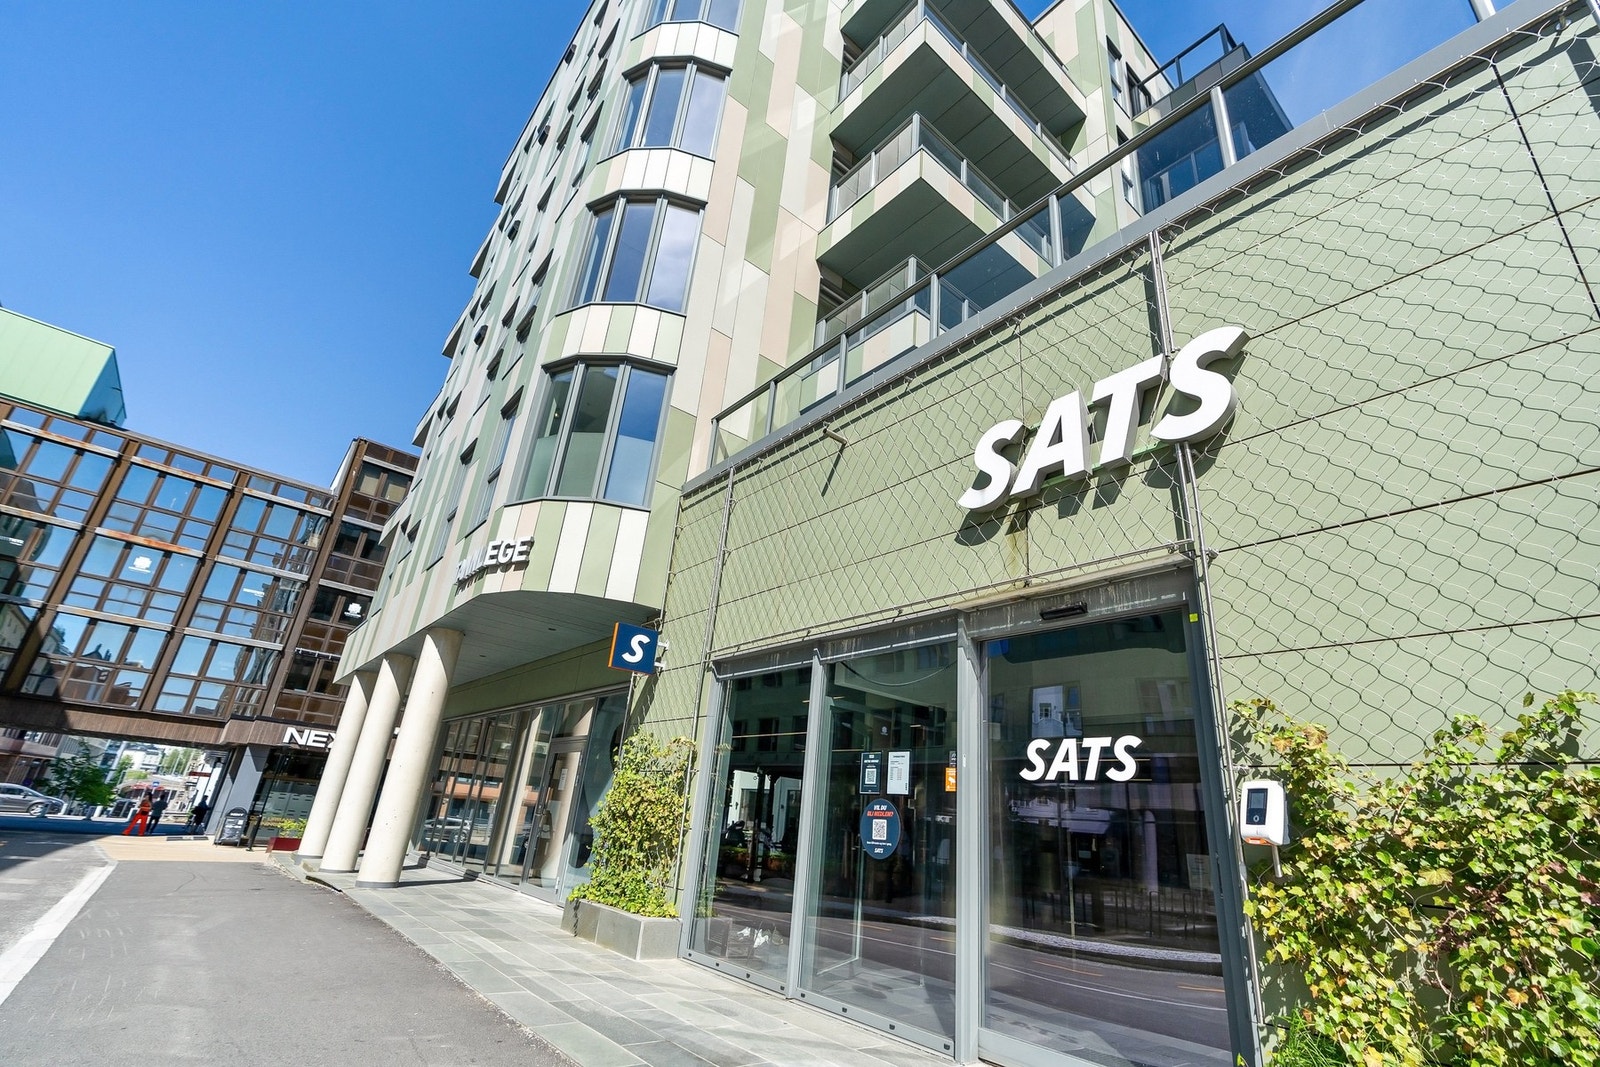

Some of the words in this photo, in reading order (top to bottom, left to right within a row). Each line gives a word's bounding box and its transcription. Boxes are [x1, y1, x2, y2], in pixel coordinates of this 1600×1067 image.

[957, 326, 1249, 512] SATS
[621, 634, 651, 664] S
[1018, 734, 1143, 782] SATS
